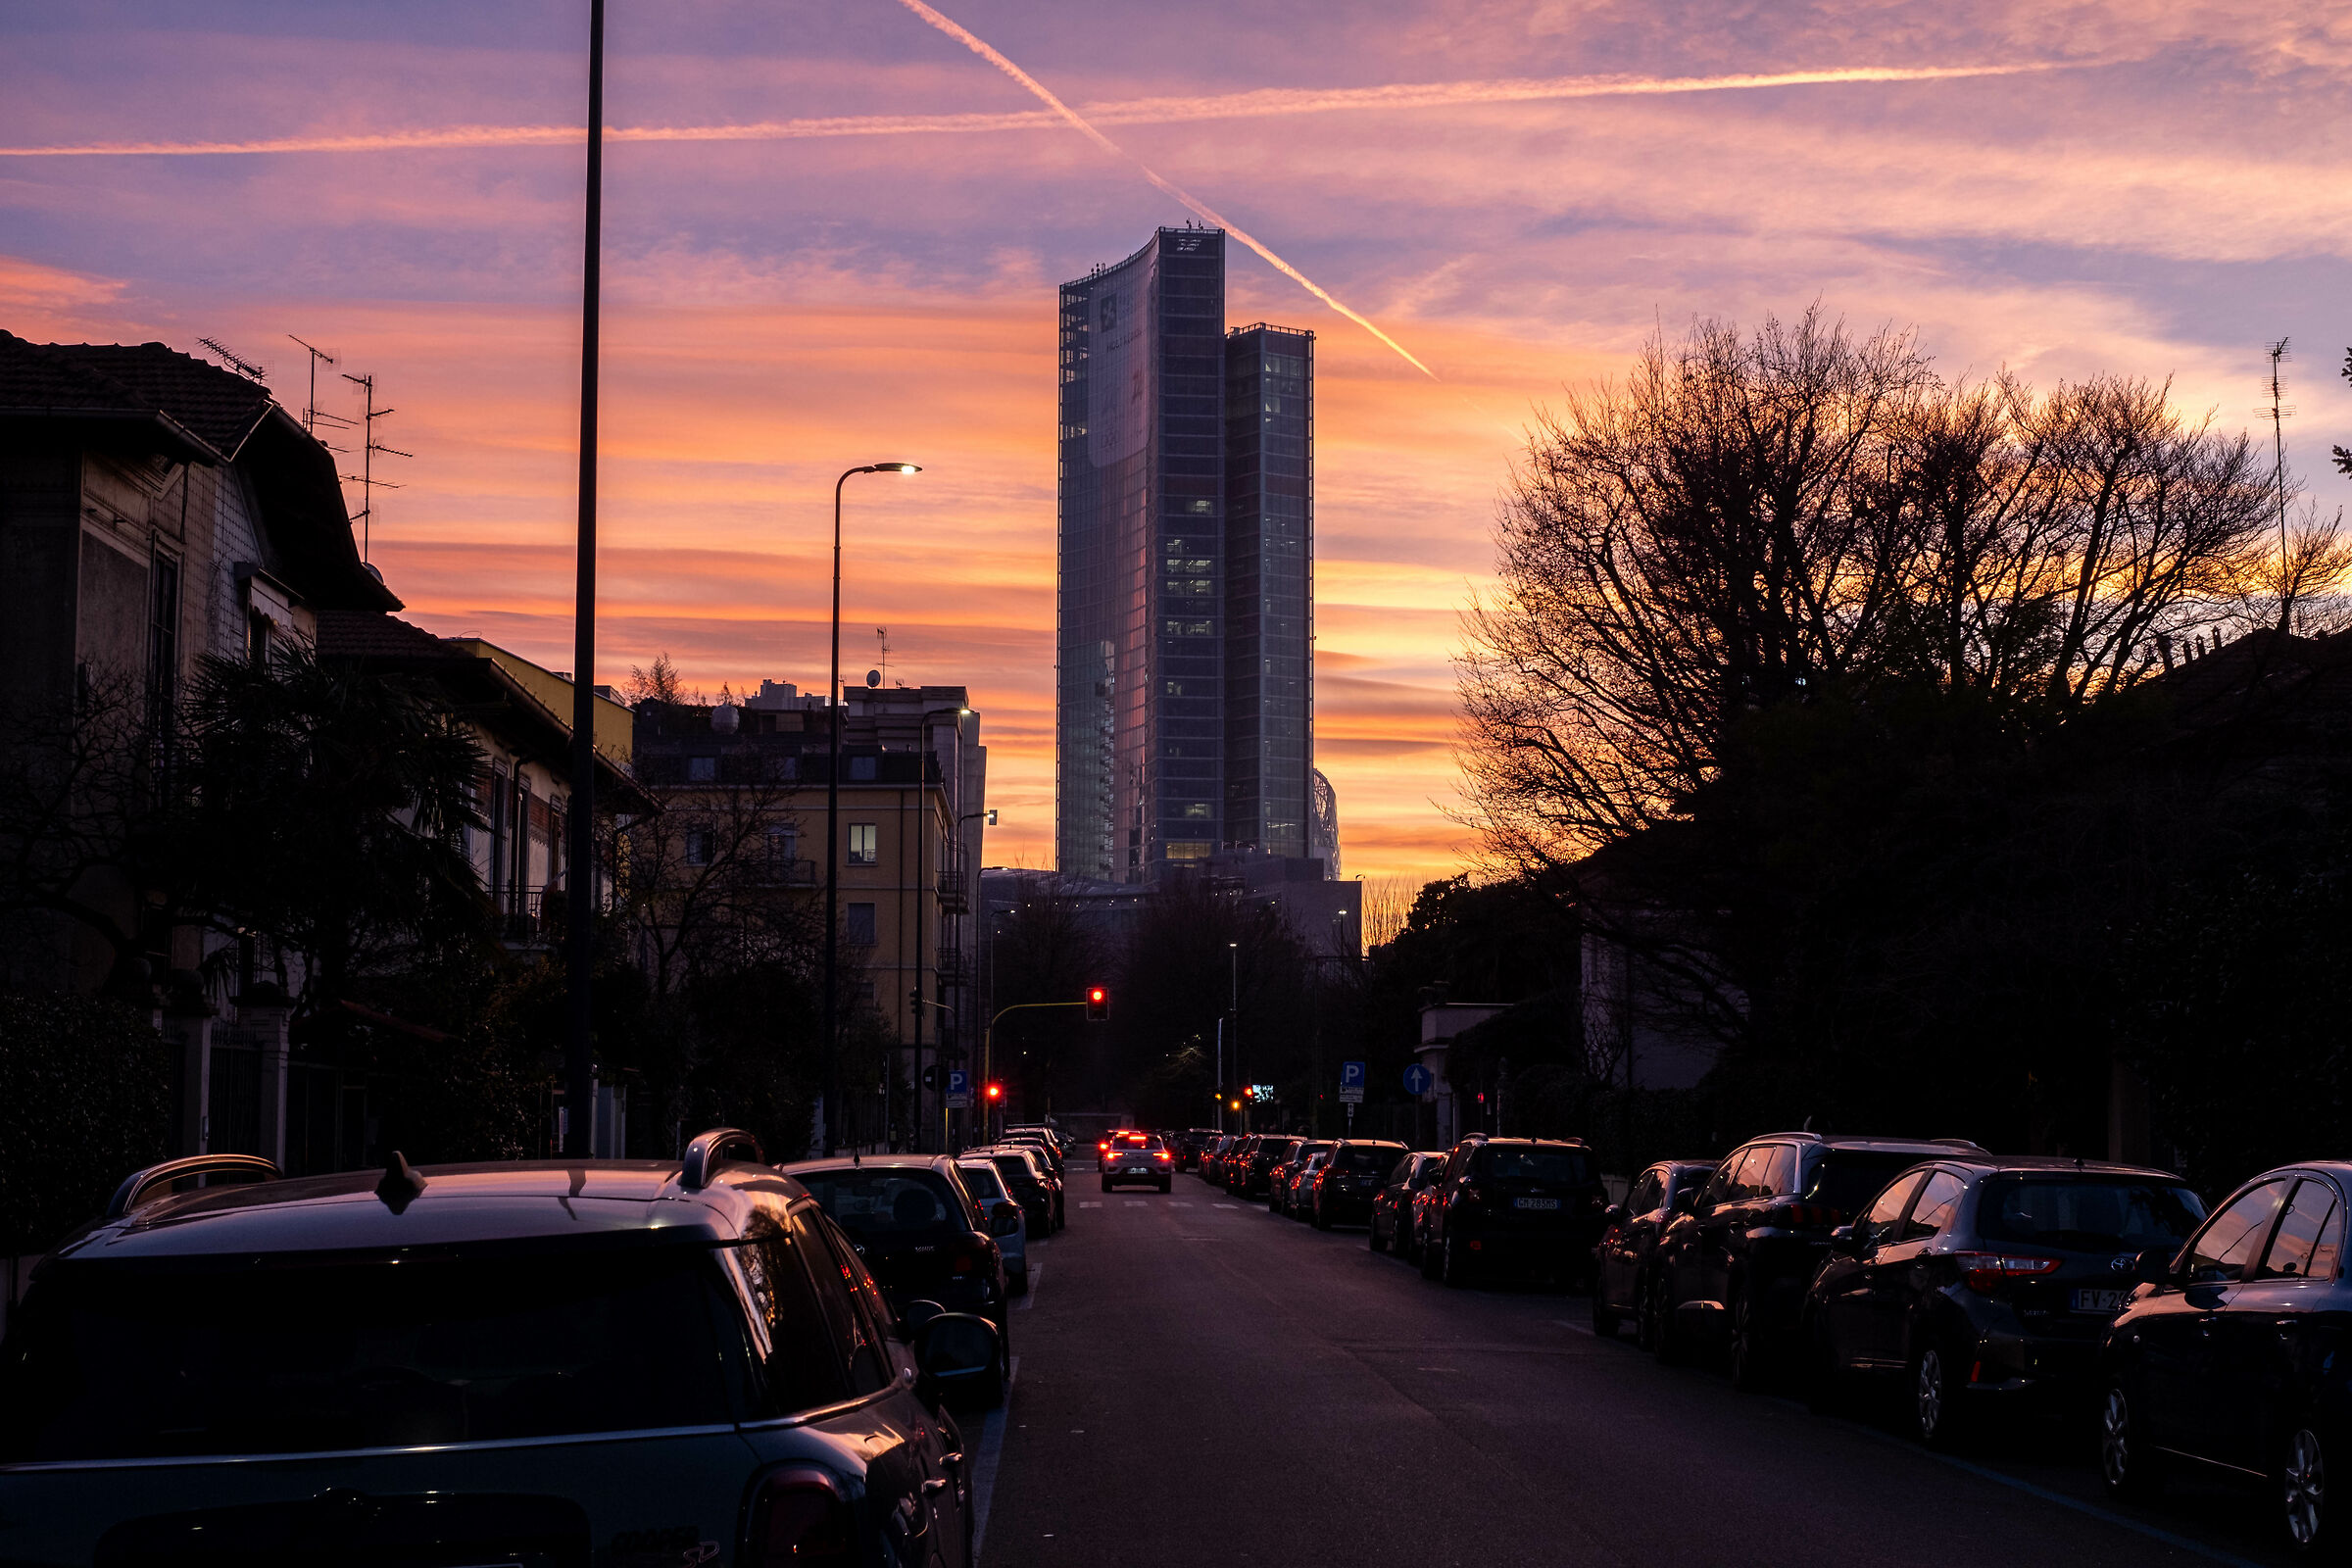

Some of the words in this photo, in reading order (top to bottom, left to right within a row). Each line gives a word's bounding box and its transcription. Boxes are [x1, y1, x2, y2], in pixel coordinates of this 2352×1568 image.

[950, 1073, 963, 1091] P
[1346, 1064, 1359, 1083] P
[2081, 1290, 2101, 1308] FV
